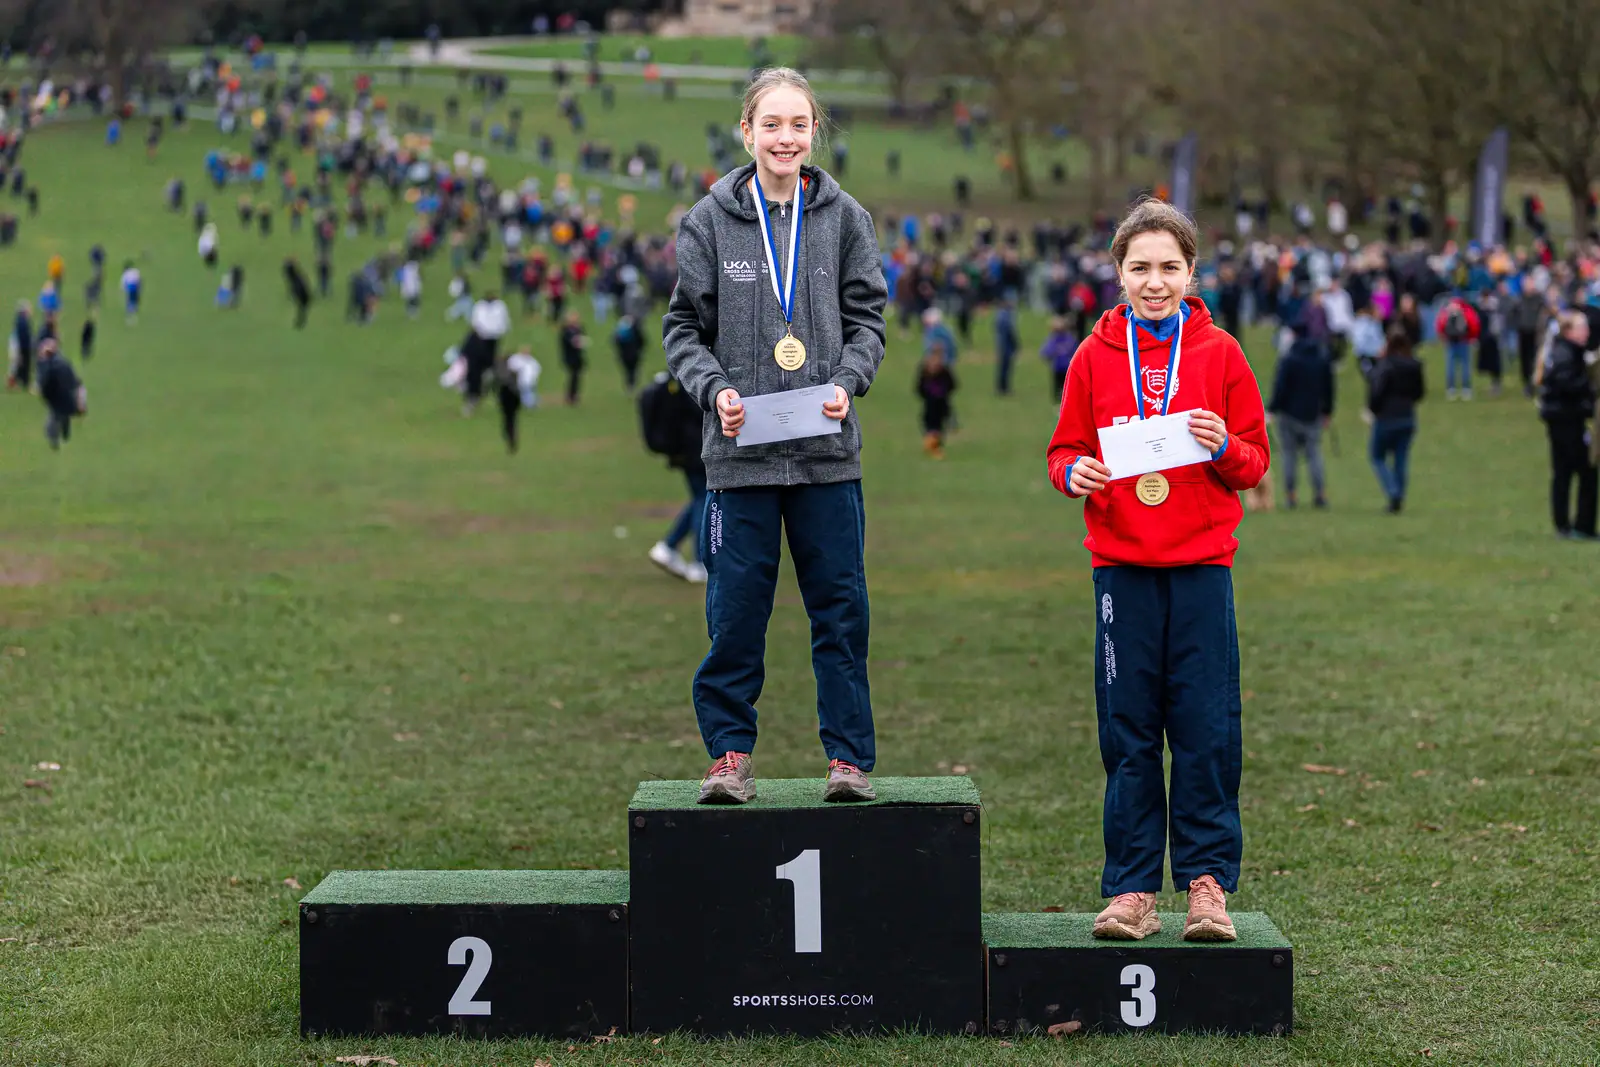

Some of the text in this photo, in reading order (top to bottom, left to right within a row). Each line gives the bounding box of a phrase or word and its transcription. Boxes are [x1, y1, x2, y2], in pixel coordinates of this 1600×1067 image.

[724, 261, 751, 269] UKA
[711, 502, 718, 511] OF
[1104, 632, 1109, 642] OF
[1109, 640, 1117, 678] CANTERBURY
[776, 849, 821, 953] 1
[447, 937, 492, 1016] 2
[733, 995, 874, 1006] SPORTSSHOES.COM
[1120, 964, 1156, 1027] 3
